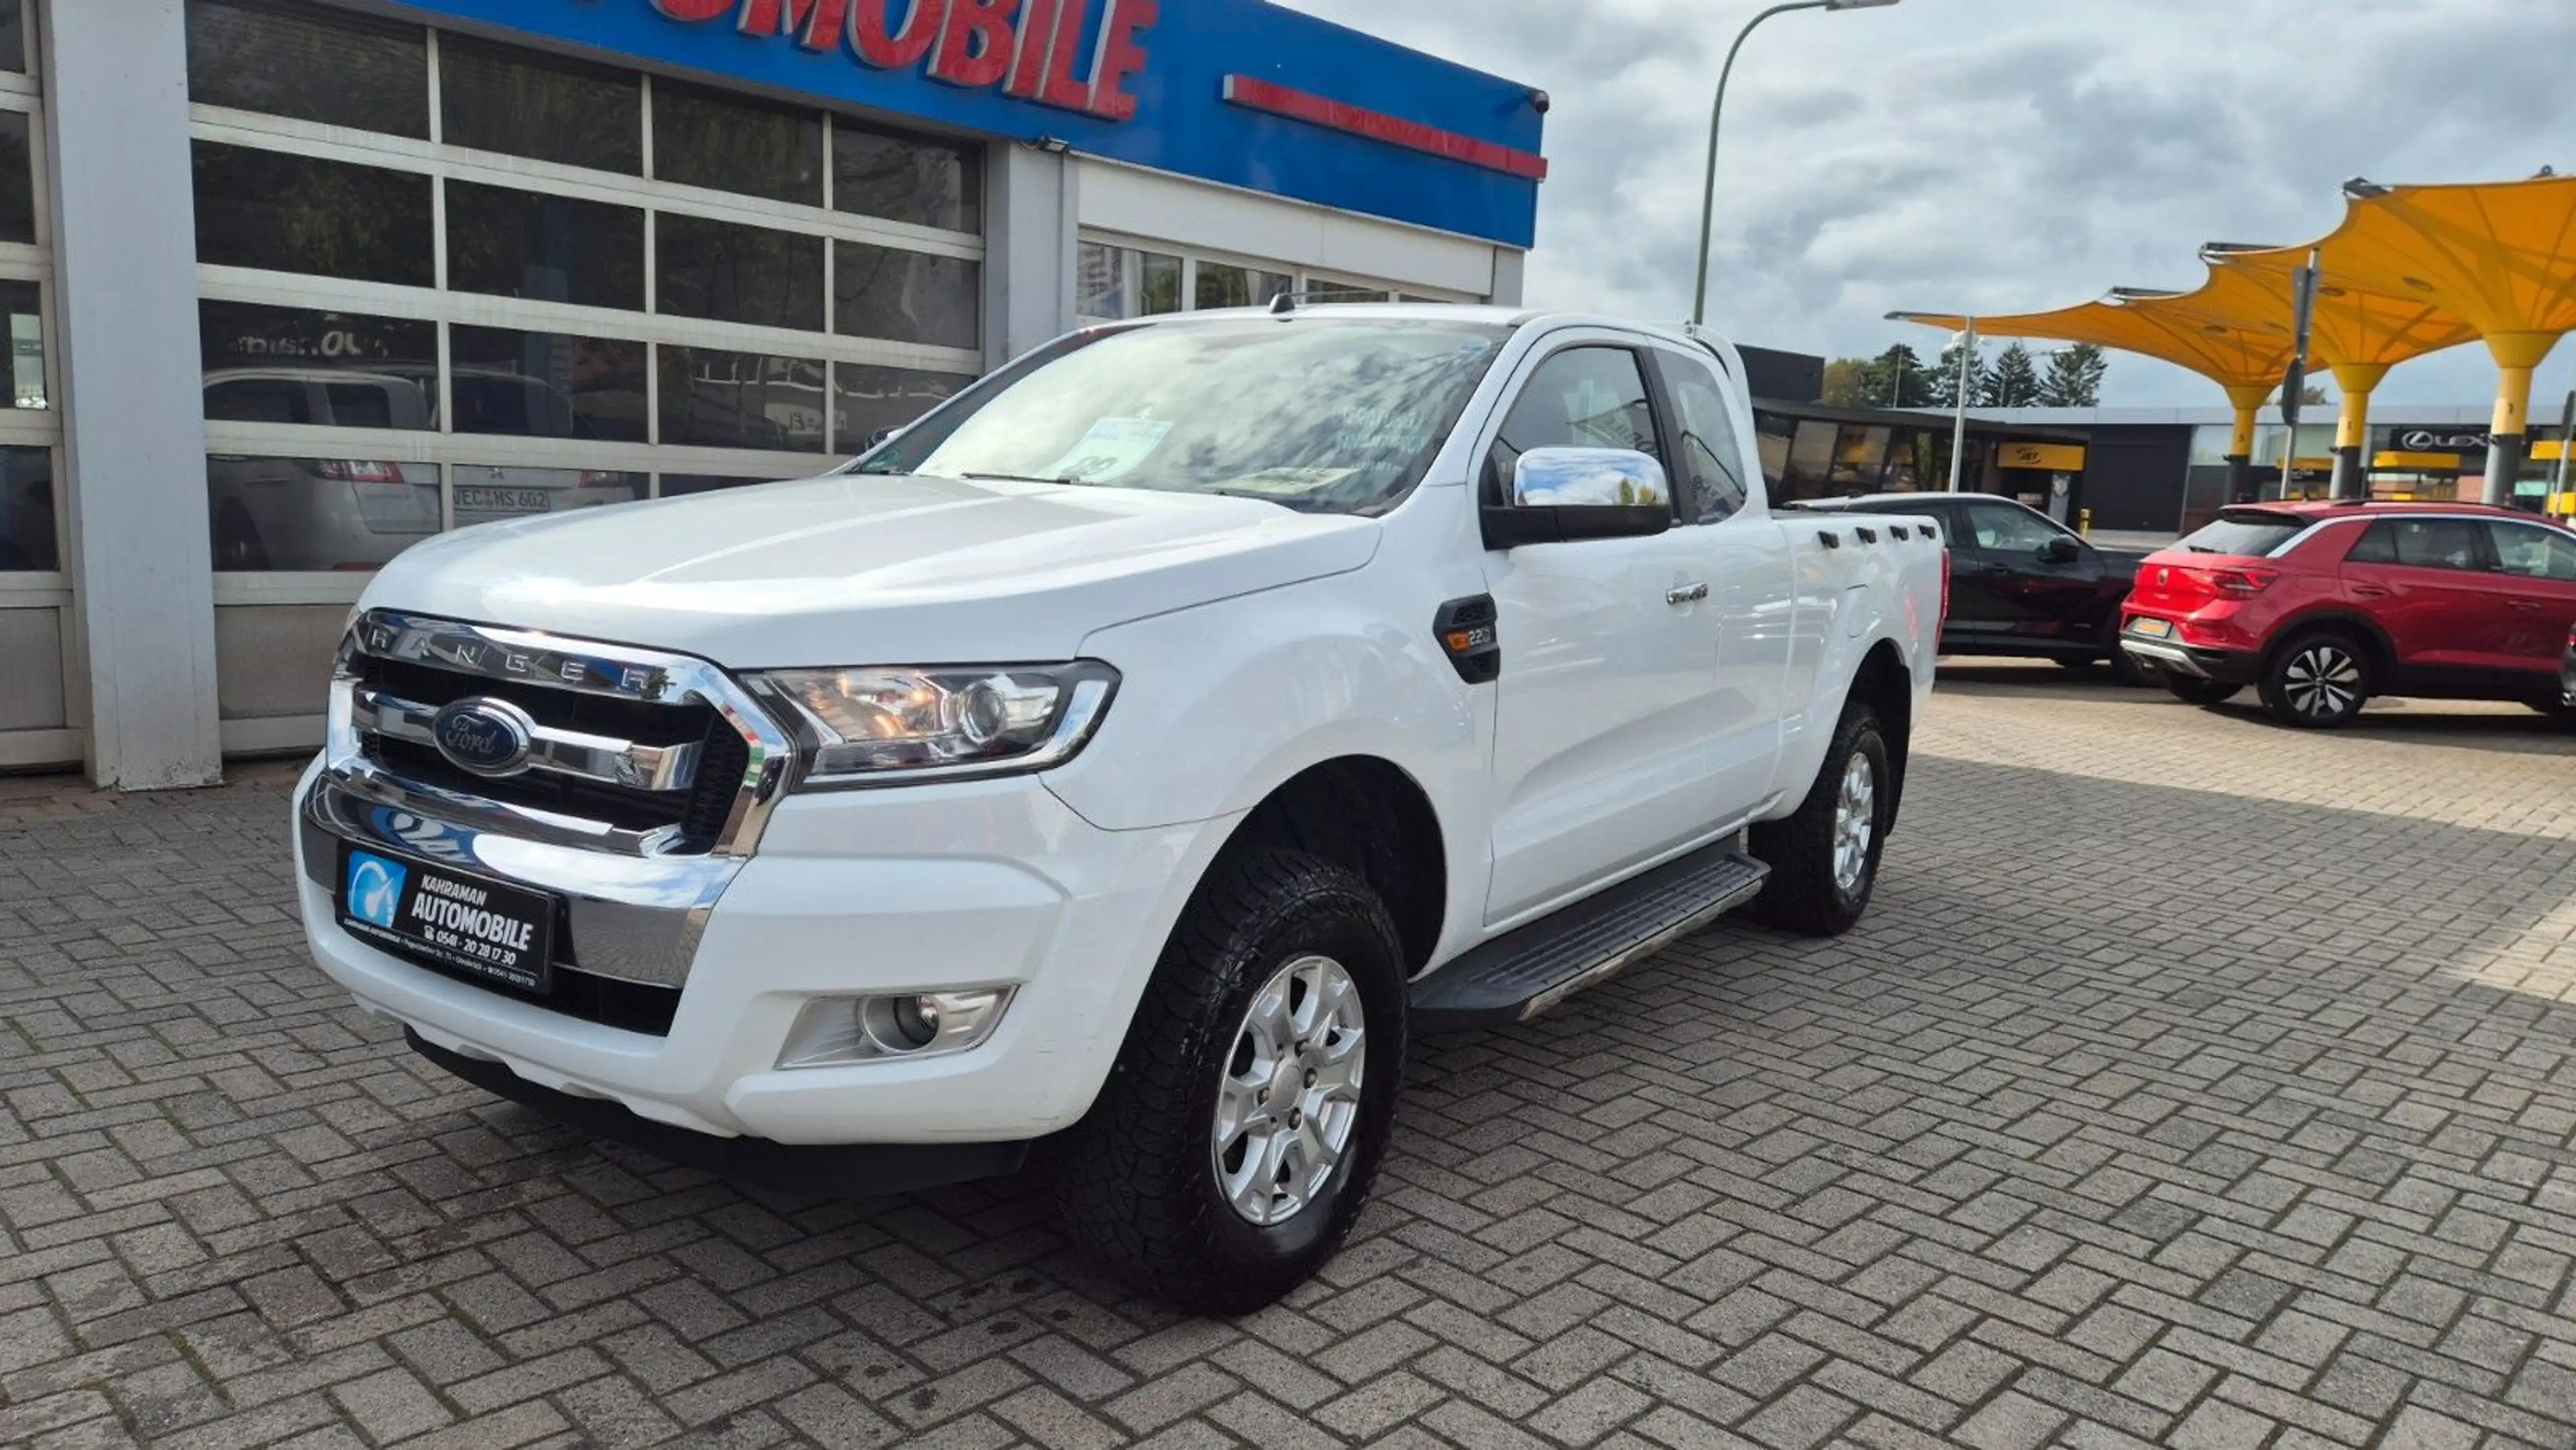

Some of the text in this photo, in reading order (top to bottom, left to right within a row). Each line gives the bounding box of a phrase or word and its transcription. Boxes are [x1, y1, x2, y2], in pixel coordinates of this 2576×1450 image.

[371, 626, 649, 691] RANGER
[445, 714, 496, 755] Ford
[421, 874, 488, 907] KAHRAMAN
[411, 893, 534, 952] AUTOMOBILE
[463, 939, 477, 954] 20
[477, 943, 490, 958] 28
[491, 947, 501, 960] 17
[502, 950, 517, 965] 30
